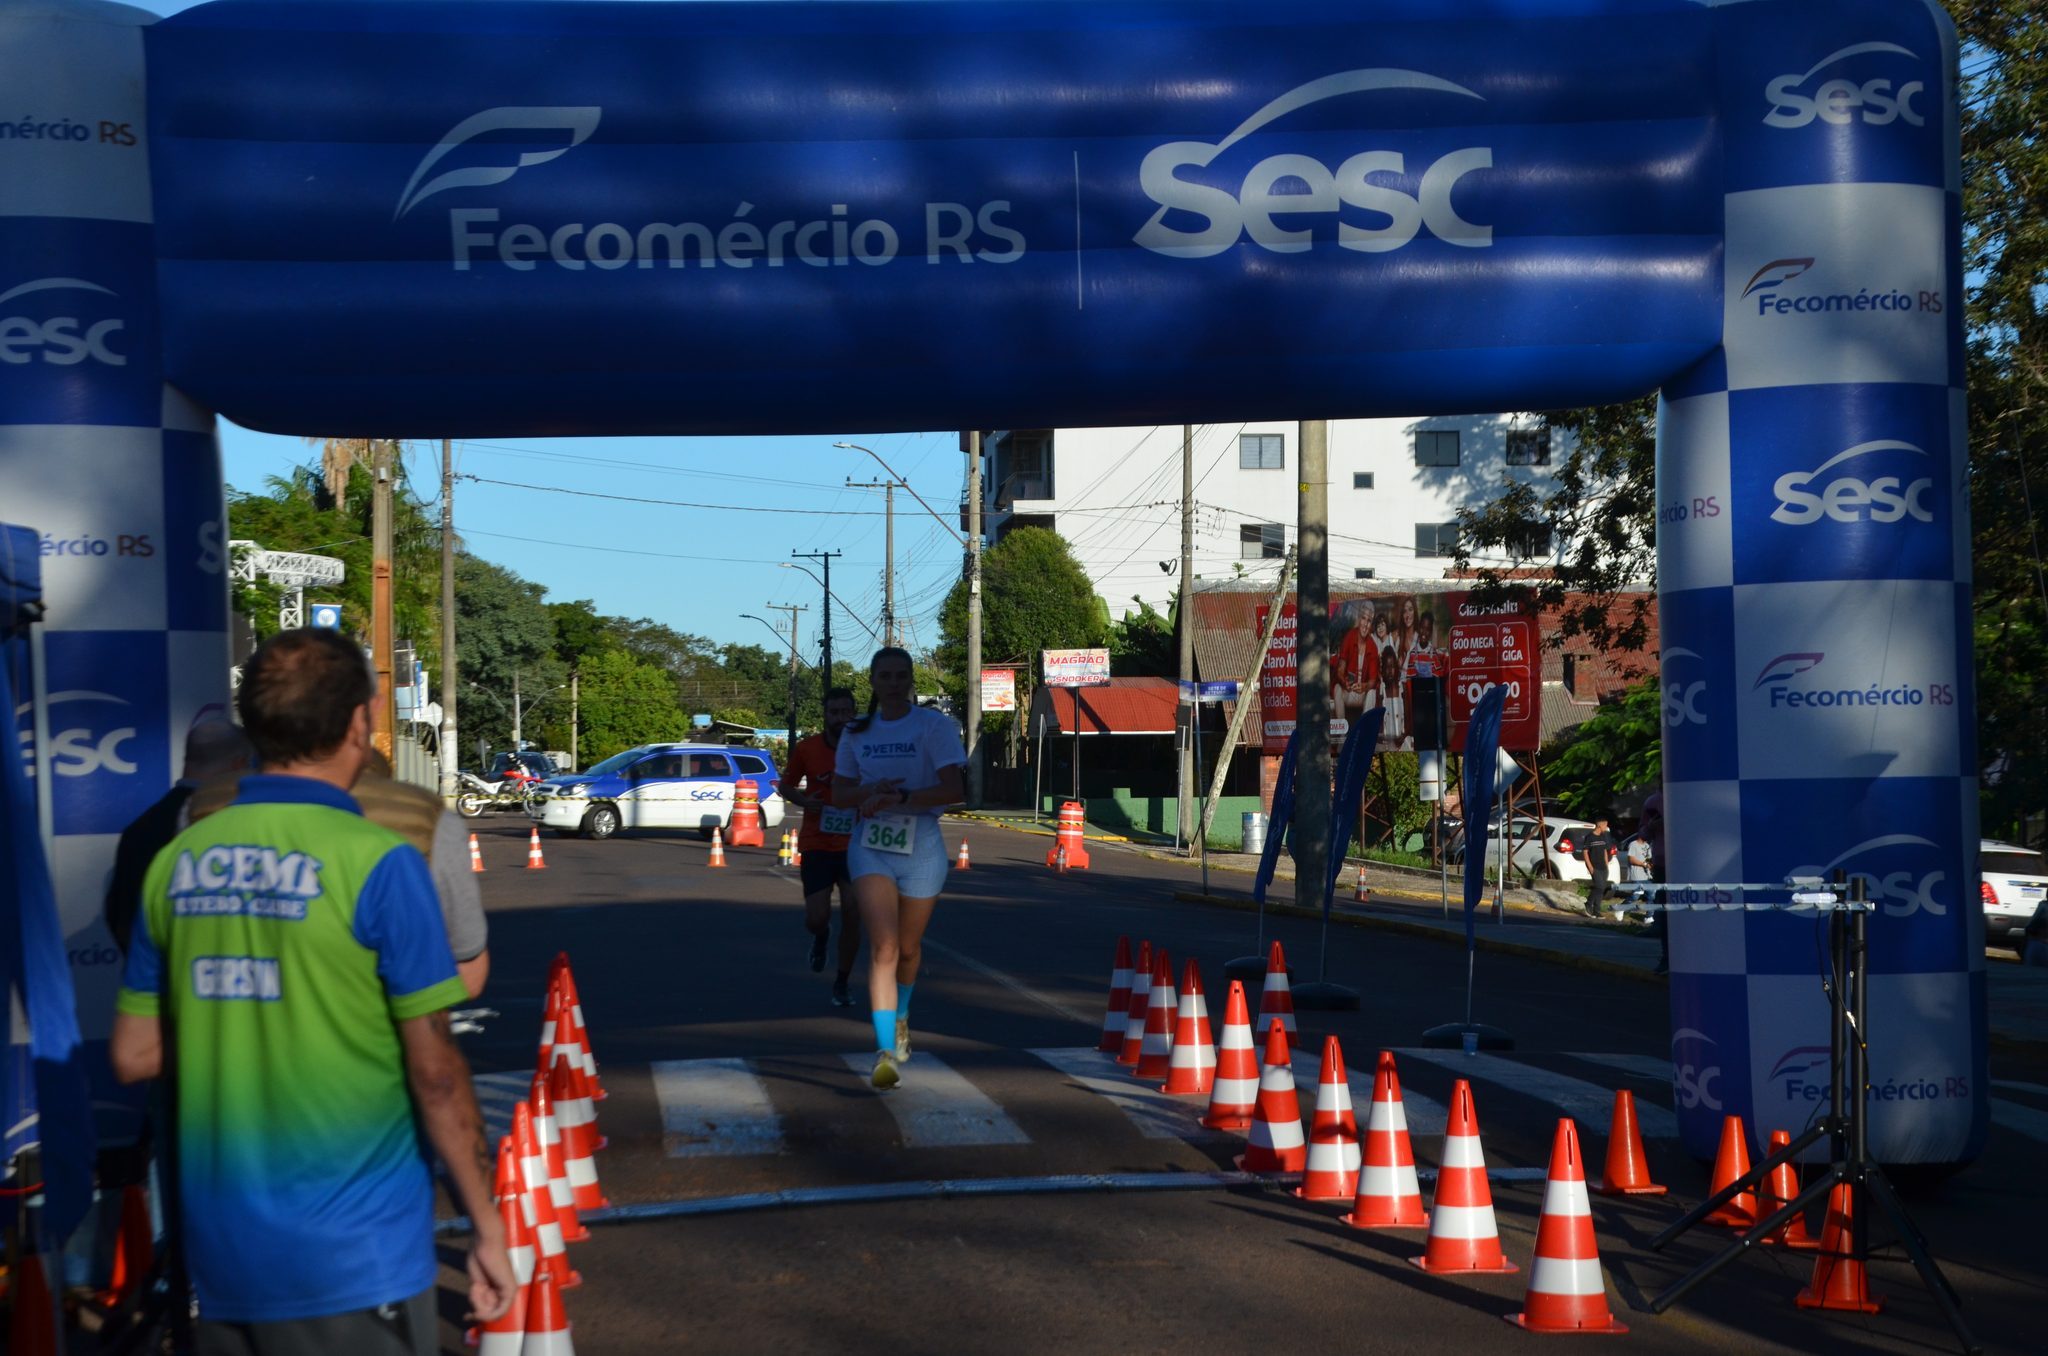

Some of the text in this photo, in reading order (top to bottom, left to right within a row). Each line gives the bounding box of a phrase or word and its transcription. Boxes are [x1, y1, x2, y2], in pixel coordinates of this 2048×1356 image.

[98, 120, 138, 146] RS
[450, 200, 1027, 271] Fecomércio RS
[1759, 289, 1942, 315] Fecomércio RS
[1693, 496, 1720, 519] RS
[117, 534, 155, 557] RS
[1453, 637, 1494, 650] 600 MEGA
[1502, 635, 1514, 647] 60
[1502, 650, 1523, 661] GIGA
[1770, 684, 1953, 708] Fecomércio RS
[872, 743, 916, 754] VETRIA
[824, 815, 852, 832] 525
[868, 823, 907, 849] 364
[1945, 1076, 1969, 1099] RS
